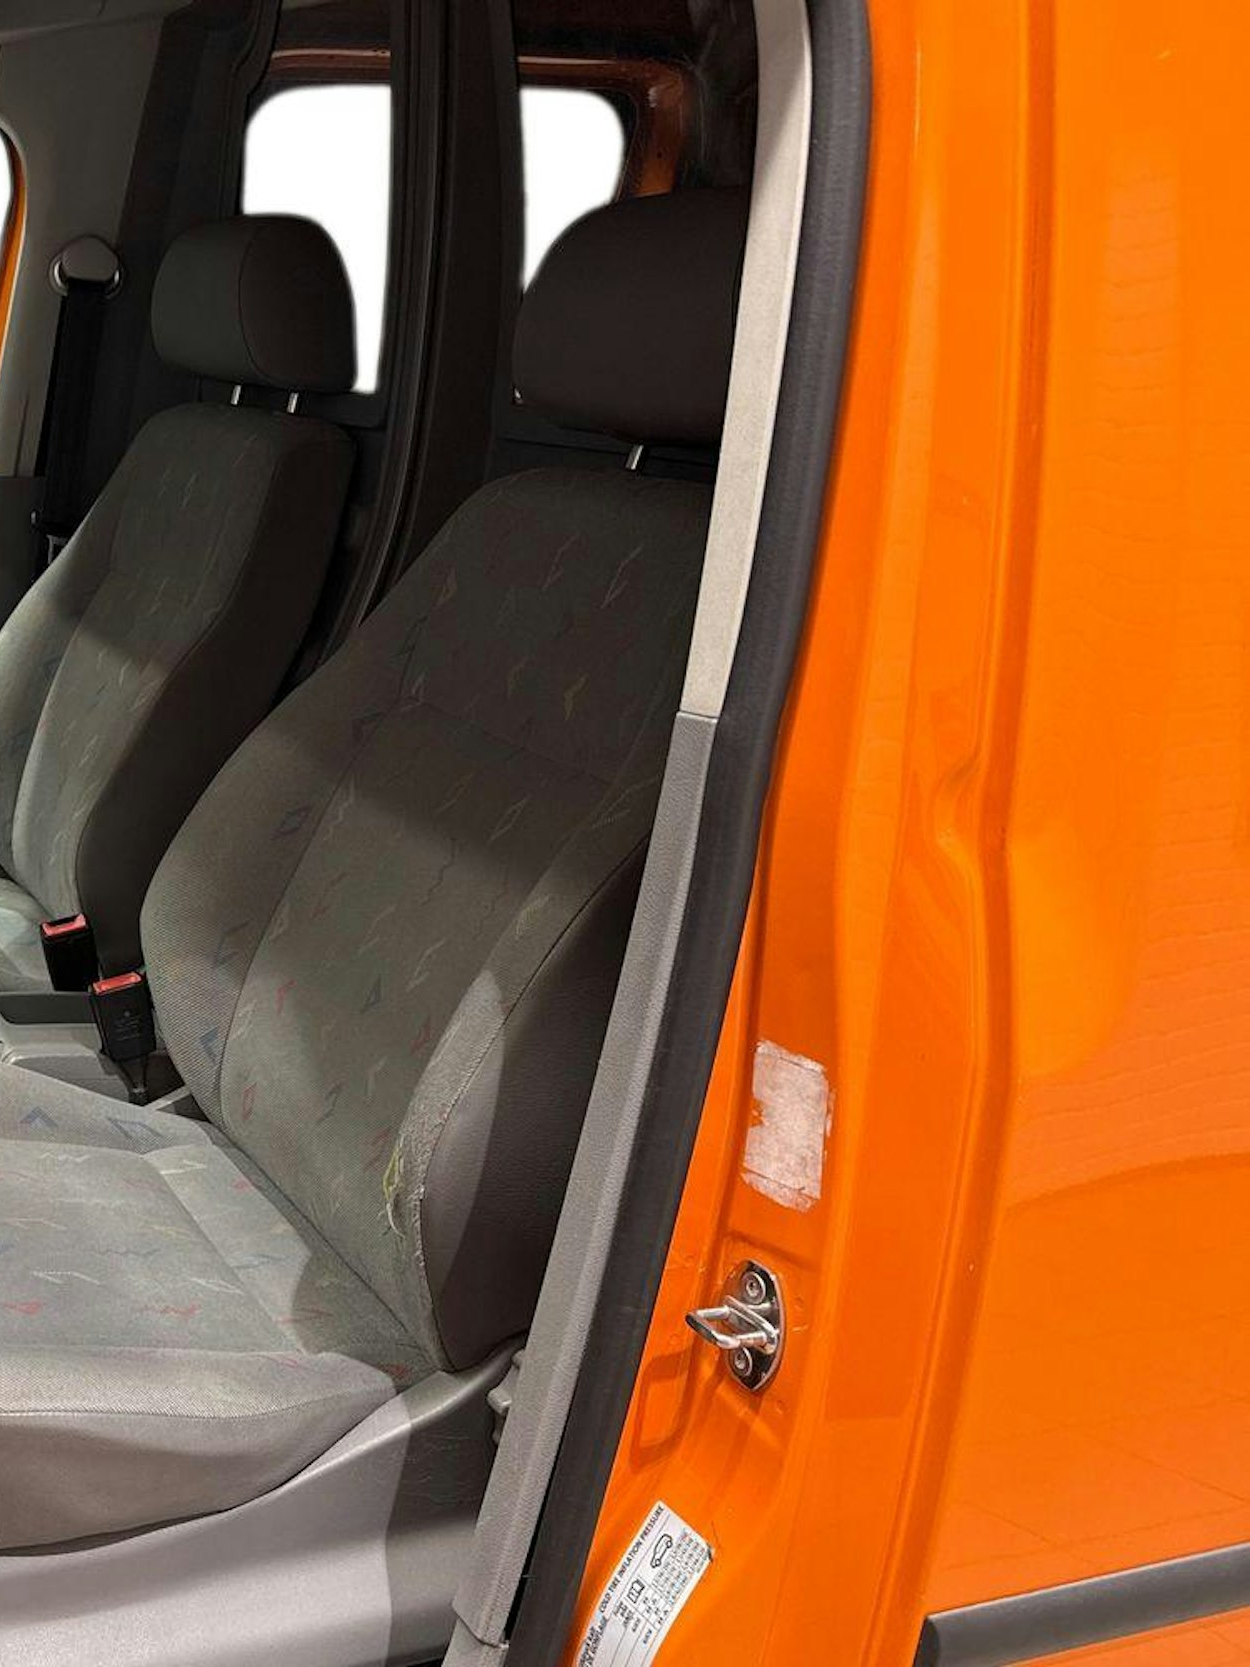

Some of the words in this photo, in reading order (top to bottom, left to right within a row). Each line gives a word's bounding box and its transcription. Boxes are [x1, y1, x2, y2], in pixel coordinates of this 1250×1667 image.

[599, 1595, 612, 1613] COLD
[608, 1578, 621, 1596] TIRE
[618, 1540, 642, 1580] INFLATION
[641, 1505, 665, 1541] PRESSURE
